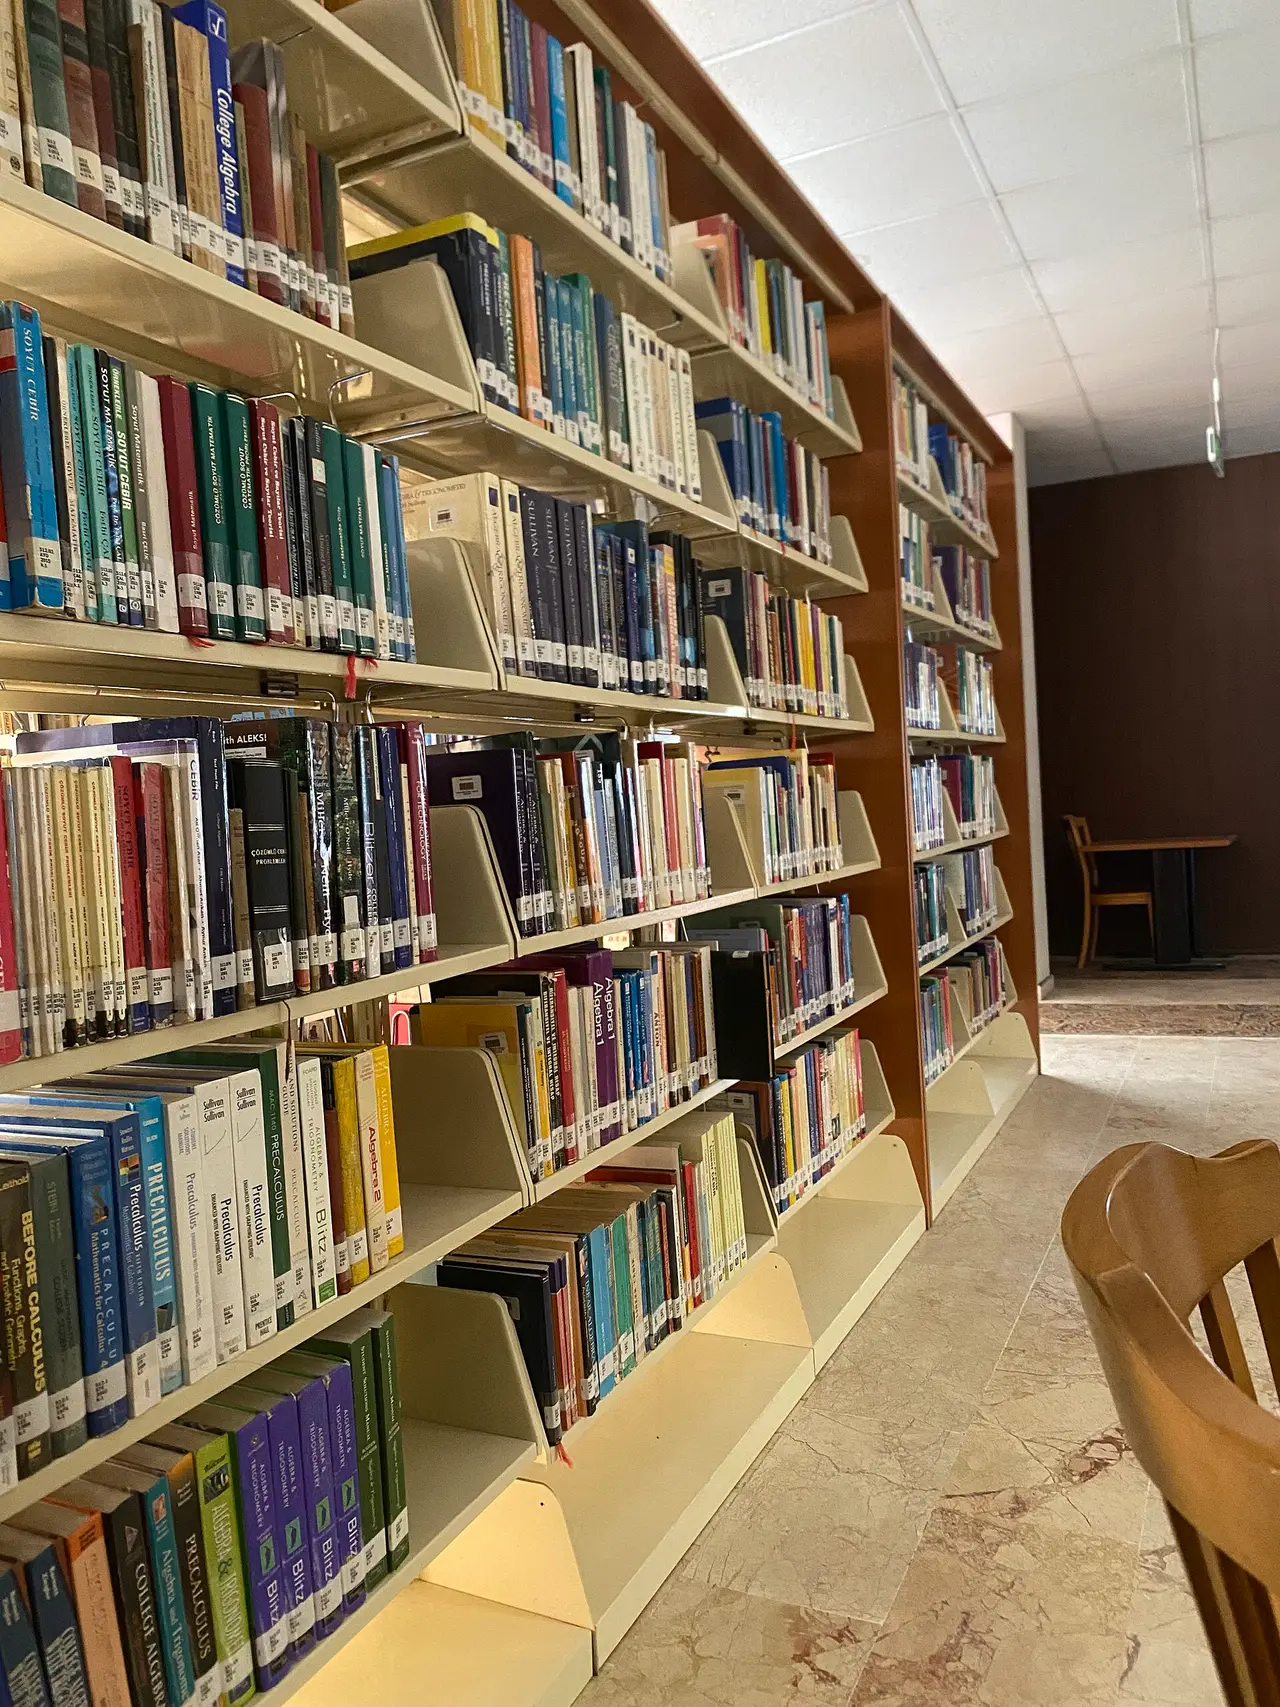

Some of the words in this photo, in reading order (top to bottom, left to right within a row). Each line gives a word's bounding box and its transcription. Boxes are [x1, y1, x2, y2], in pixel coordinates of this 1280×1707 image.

[216, 88, 234, 151] College
[219, 149, 239, 214] Algebra
[502, 273, 516, 374] PRECALCULUS
[23, 327, 36, 372] SOYUT
[26, 378, 39, 421] CEBİR
[100, 367, 111, 404] SOYUT
[72, 416, 83, 454] SOYUT
[91, 416, 101, 454] SOYUT
[104, 406, 117, 469] MATEMATİK
[131, 404, 140, 433] Soyut
[117, 431, 129, 469] SOYUT
[134, 433, 144, 485] Matematik
[238, 447, 246, 472] SOYUT
[66, 460, 74, 491] SOYUT
[95, 458, 105, 496] CEBİR
[120, 474, 132, 510] CEBİR
[210, 461, 218, 486] SOYUT
[527, 500, 539, 557] SULLIVAN
[545, 508, 556, 564] SULLIVAN
[563, 512, 573, 567] SULLIVAN
[236, 733, 267, 744] ALEKS!
[190, 759, 200, 801] CEBİR
[415, 781, 423, 798] FOR
[416, 800, 427, 860] TECHNOLOGY
[364, 822, 375, 885] Blitzer
[593, 982, 604, 1038] Algebra
[605, 977, 615, 1032] Algebra
[203, 1098, 224, 1111] Sullivan
[236, 1087, 256, 1099] Sullivan
[236, 1099, 256, 1111] Sullivan
[268, 1089, 276, 1110] MAC
[203, 1110, 225, 1123] Sullivan
[290, 1099, 299, 1152] SOLUTIONS
[308, 1117, 319, 1191] TRIGONOMETRY
[368, 1126, 380, 1188] Algebra
[374, 1189, 381, 1203] 2
[242, 1179, 250, 1203] ENHANCED
[270, 1134, 285, 1221] PRECALCULUS
[129, 1184, 147, 1252] Precalculus
[147, 1162, 171, 1282] PRECALCULUS
[185, 1172, 200, 1230] Precalculus
[210, 1193, 218, 1217] ENHANCED
[252, 1184, 267, 1246] Precalculus
[291, 1168, 301, 1238] PRECALCULUS
[21, 1210, 38, 1287] BEFORE
[121, 1205, 133, 1252] Mathematics
[213, 1231, 221, 1254] GRAPHING
[220, 1198, 236, 1262] Precalculus
[245, 1216, 253, 1239] GRAPHING
[90, 1232, 102, 1294] Mathematics
[125, 1252, 134, 1263] for
[126, 1265, 136, 1296] Calculus
[215, 1254, 223, 1275] UTILITIES
[10, 1258, 24, 1312] Functions,
[95, 1296, 104, 1310] for
[14, 1314, 27, 1358] Graphs,
[28, 1290, 47, 1392] CALCULUS
[95, 1312, 107, 1353] Calculus
[316, 1427, 326, 1464] ALGEBRA
[335, 1404, 346, 1469] TRIGONOMETRY
[343, 1409, 351, 1444] ALGEBRA
[278, 1440, 290, 1509] TRIGONOMETRY
[287, 1445, 297, 1485] ALGEBRA
[309, 1421, 320, 1489] TRIGONOMETRY
[250, 1459, 264, 1528] TRIGONOMETRY
[259, 1464, 269, 1501] ALGEBRA
[211, 1501, 233, 1560] ALGEBRA
[161, 1550, 176, 1604] Algebra
[169, 1606, 178, 1625] and
[218, 1558, 234, 1577] &
[185, 1534, 211, 1660] PRECALCULUS
[135, 1563, 155, 1641] COLLEGE
[146, 1642, 166, 1707] ALGEBRA
